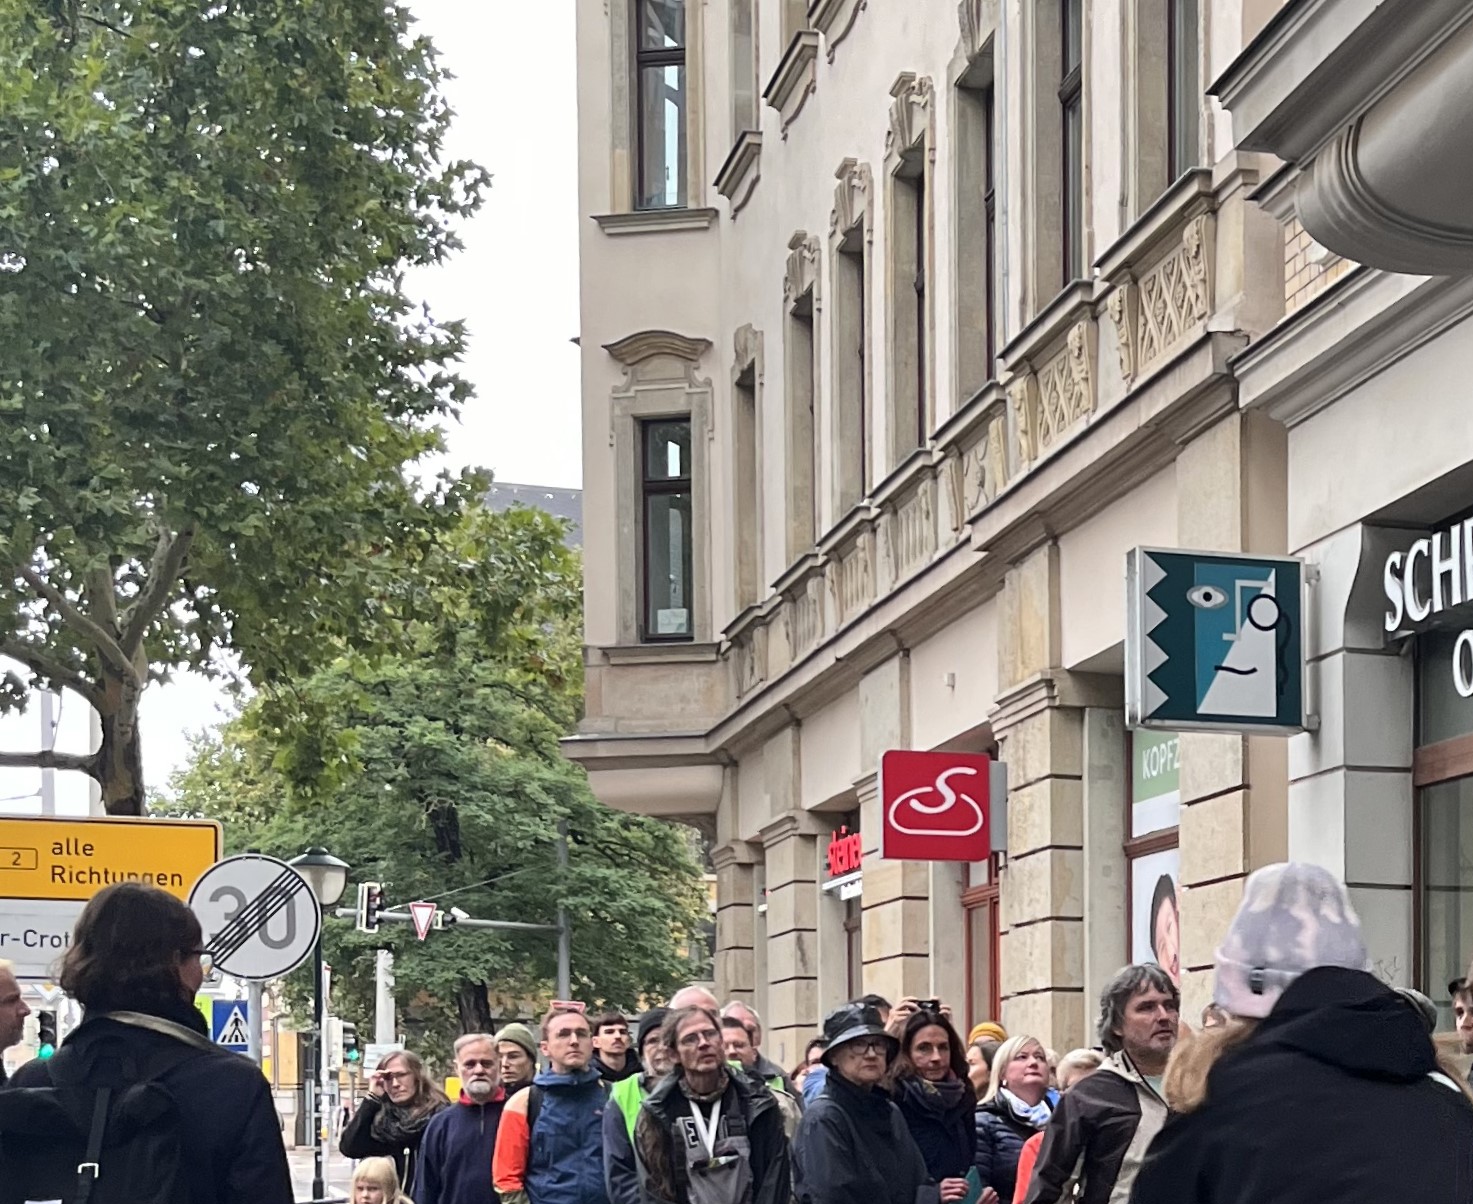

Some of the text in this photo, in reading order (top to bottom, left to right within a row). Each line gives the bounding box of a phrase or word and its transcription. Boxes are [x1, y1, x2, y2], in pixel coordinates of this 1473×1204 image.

[51, 837, 95, 857] alle
[12, 851, 22, 867] 2
[209, 886, 297, 950] 30
